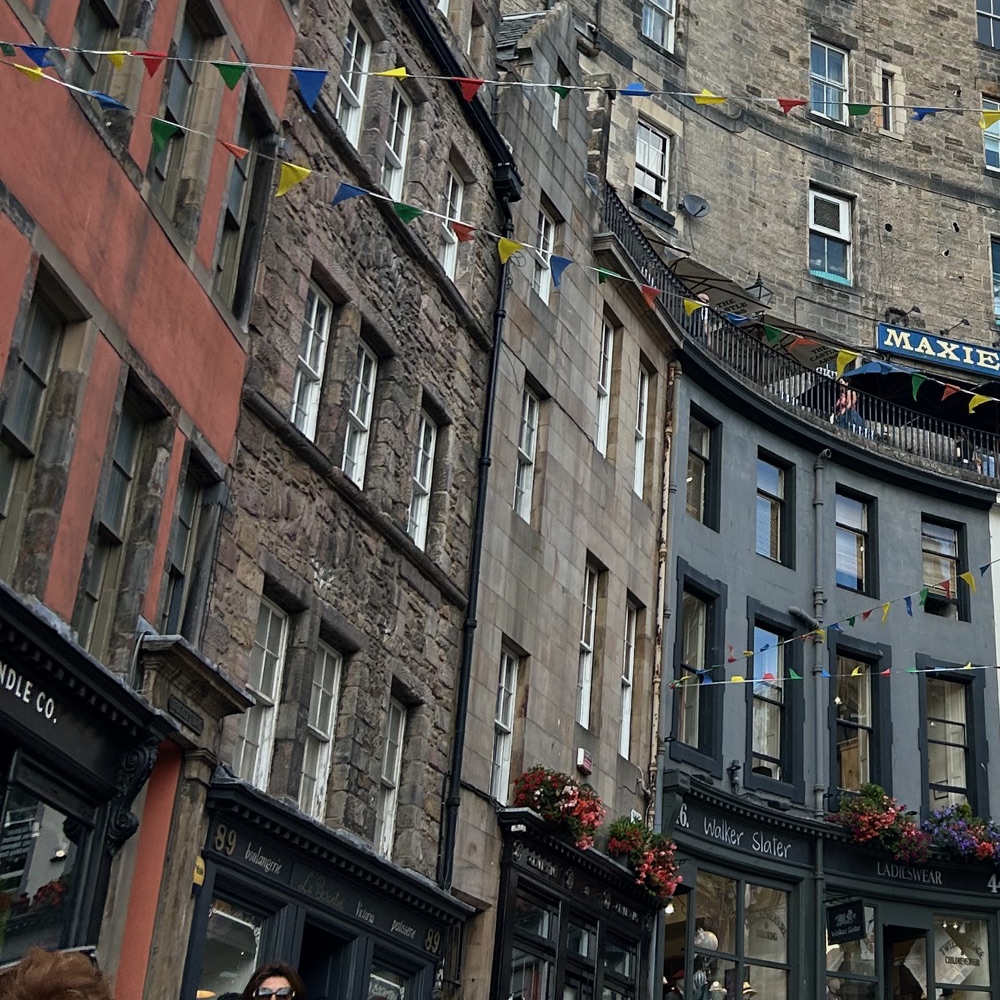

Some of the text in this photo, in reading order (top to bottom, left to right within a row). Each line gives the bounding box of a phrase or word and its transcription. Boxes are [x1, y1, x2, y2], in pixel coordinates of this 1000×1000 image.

[36, 692, 57, 724] CO.
[215, 824, 282, 875] 89 boulangerie
[704, 816, 744, 846] Walker
[752, 831, 791, 859] Slater
[877, 861, 943, 885] LADIESWEAR
[425, 928, 441, 954] 89
